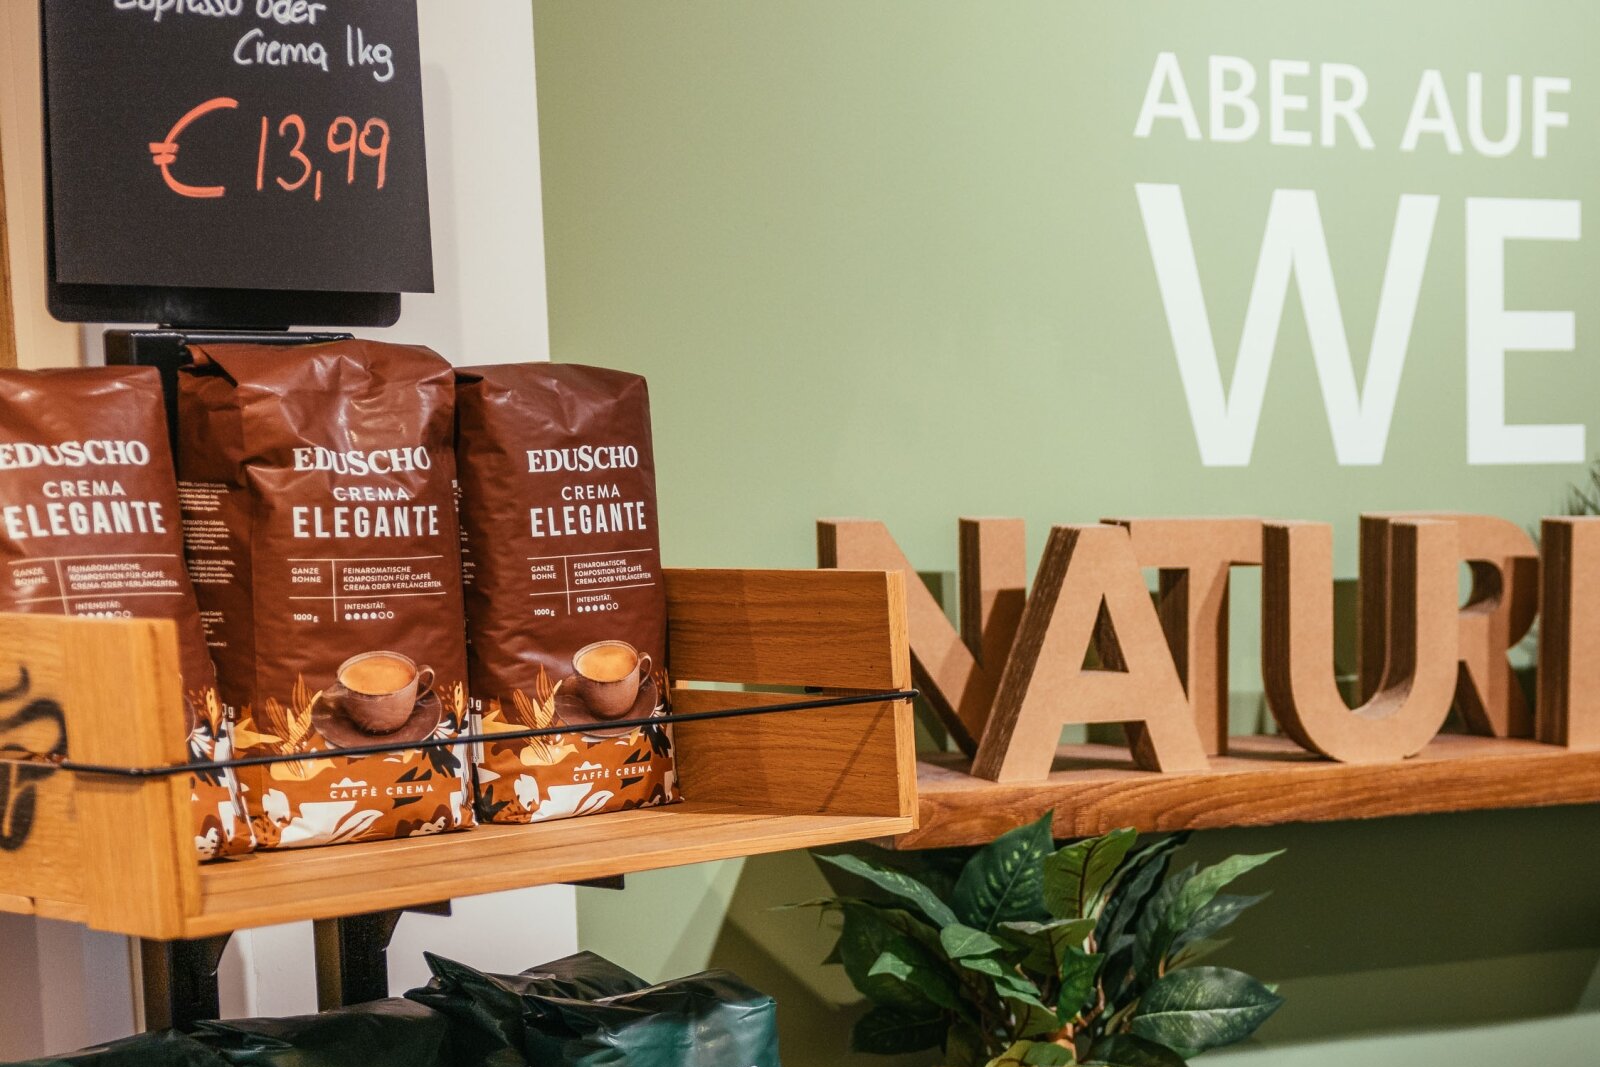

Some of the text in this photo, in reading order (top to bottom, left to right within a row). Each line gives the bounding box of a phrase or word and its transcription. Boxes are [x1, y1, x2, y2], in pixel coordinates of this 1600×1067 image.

[256, 0, 327, 25] oder
[233, 28, 329, 71] Crema
[1133, 52, 1376, 150] ABER
[1399, 68, 1572, 158] AUF
[256, 114, 390, 201] 13,99
[0, 440, 151, 469] EDUSCHO
[293, 446, 432, 476] EDUSCHO
[526, 445, 639, 473] EDUSCHO
[43, 480, 128, 499] CREMA
[333, 487, 411, 501] CREMA
[561, 484, 621, 501] CREMA
[3, 501, 167, 540] ELEGANTE
[292, 505, 440, 539] ELEGANTE
[530, 501, 647, 538] ELEGANTE
[291, 567, 320, 575] GANZE
[343, 566, 412, 574] FEINAROMATISCHE
[531, 564, 554, 572] GANZE
[573, 559, 627, 569] FEINAROMATISCHE
[574, 568, 616, 577] KOMPOSITION
[616, 566, 627, 574] FÜR
[292, 575, 322, 583] BOHNE
[343, 574, 394, 583] KOMPOSITION
[395, 573, 410, 581] FÜR
[344, 602, 386, 610] INTENSITÄT:
[576, 594, 612, 603] INTENSITÄT:
[573, 766, 653, 782] CAFFÈ CREMA
[330, 784, 434, 799] CAFFÈ CREMA
